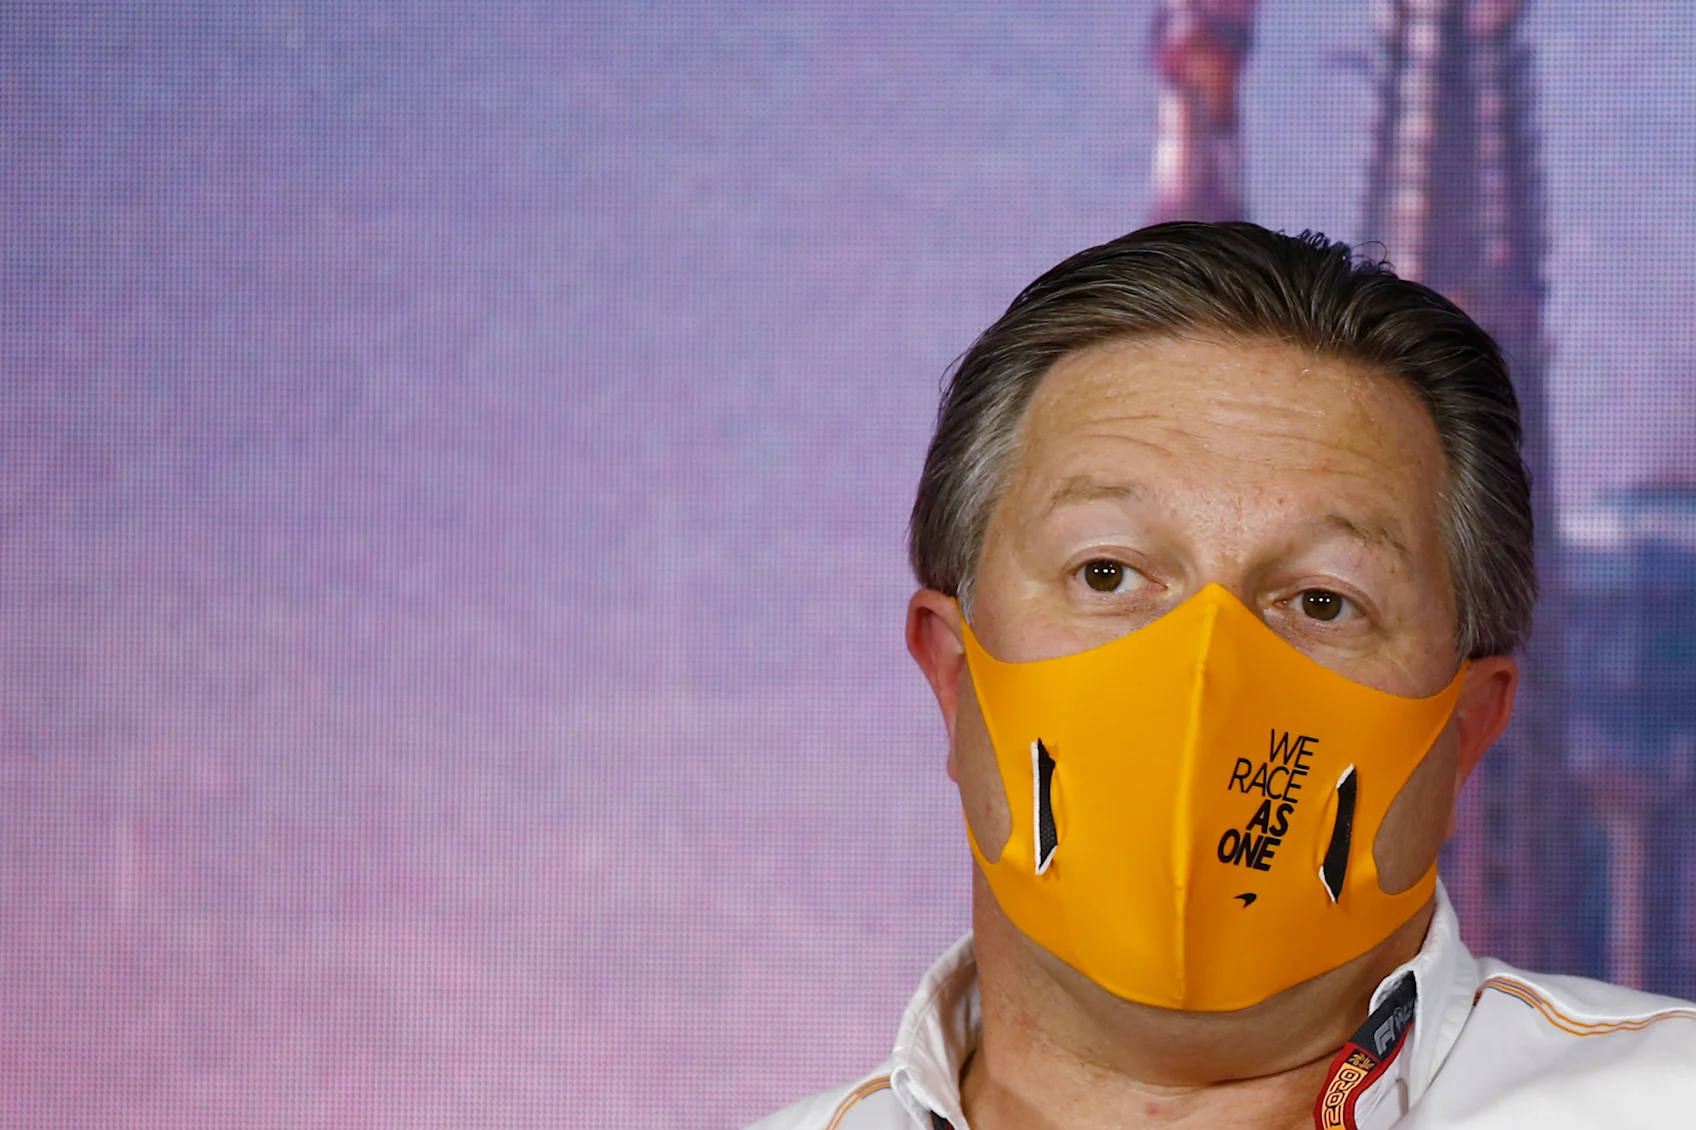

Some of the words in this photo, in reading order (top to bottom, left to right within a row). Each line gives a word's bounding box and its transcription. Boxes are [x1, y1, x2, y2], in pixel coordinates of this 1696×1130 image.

[1269, 728, 1319, 770] WE
[1227, 757, 1308, 803] RACE
[1246, 799, 1294, 837] AS
[1217, 828, 1281, 872] ONE
[1322, 1065, 1362, 1129] 2020
